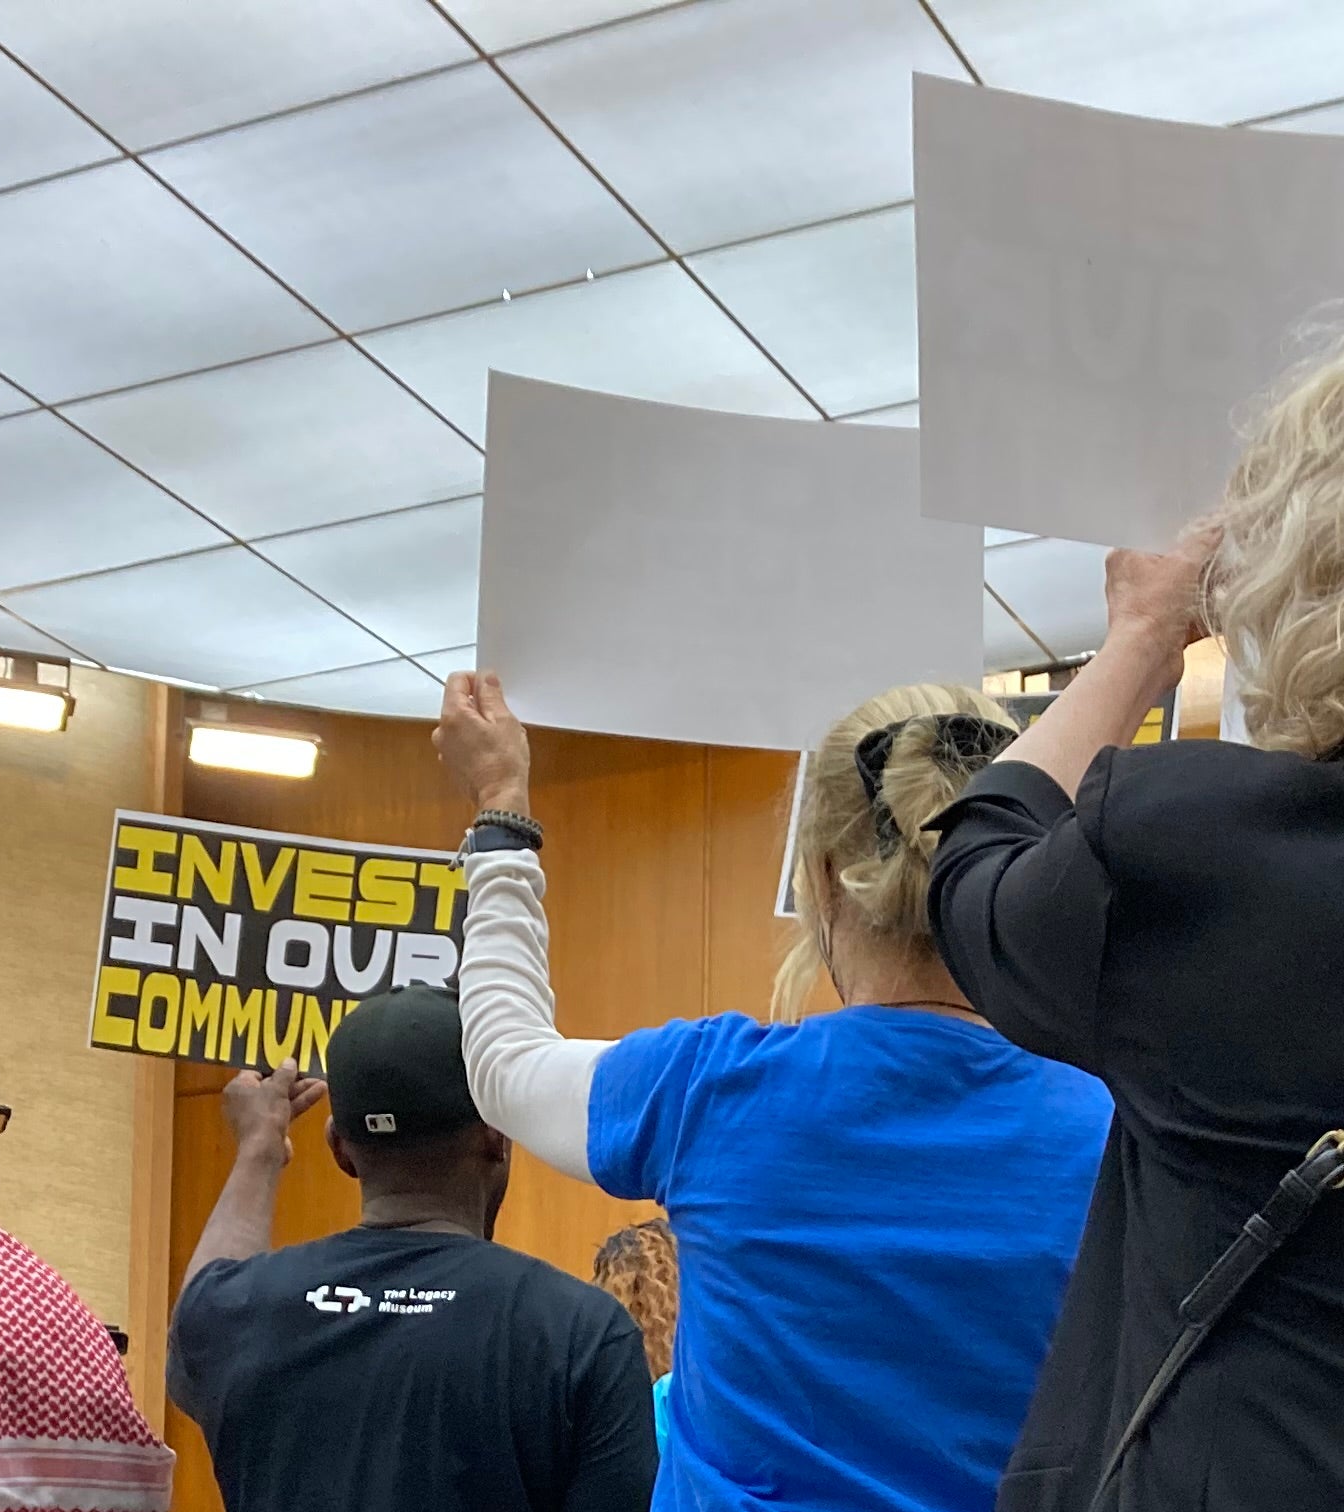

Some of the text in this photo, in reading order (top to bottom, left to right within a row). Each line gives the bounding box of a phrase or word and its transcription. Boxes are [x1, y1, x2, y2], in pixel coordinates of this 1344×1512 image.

[113, 824, 468, 931] INVEST
[109, 895, 458, 993] IN OUR
[378, 1301, 433, 1314] Museum
[409, 1287, 457, 1301] Legacy
